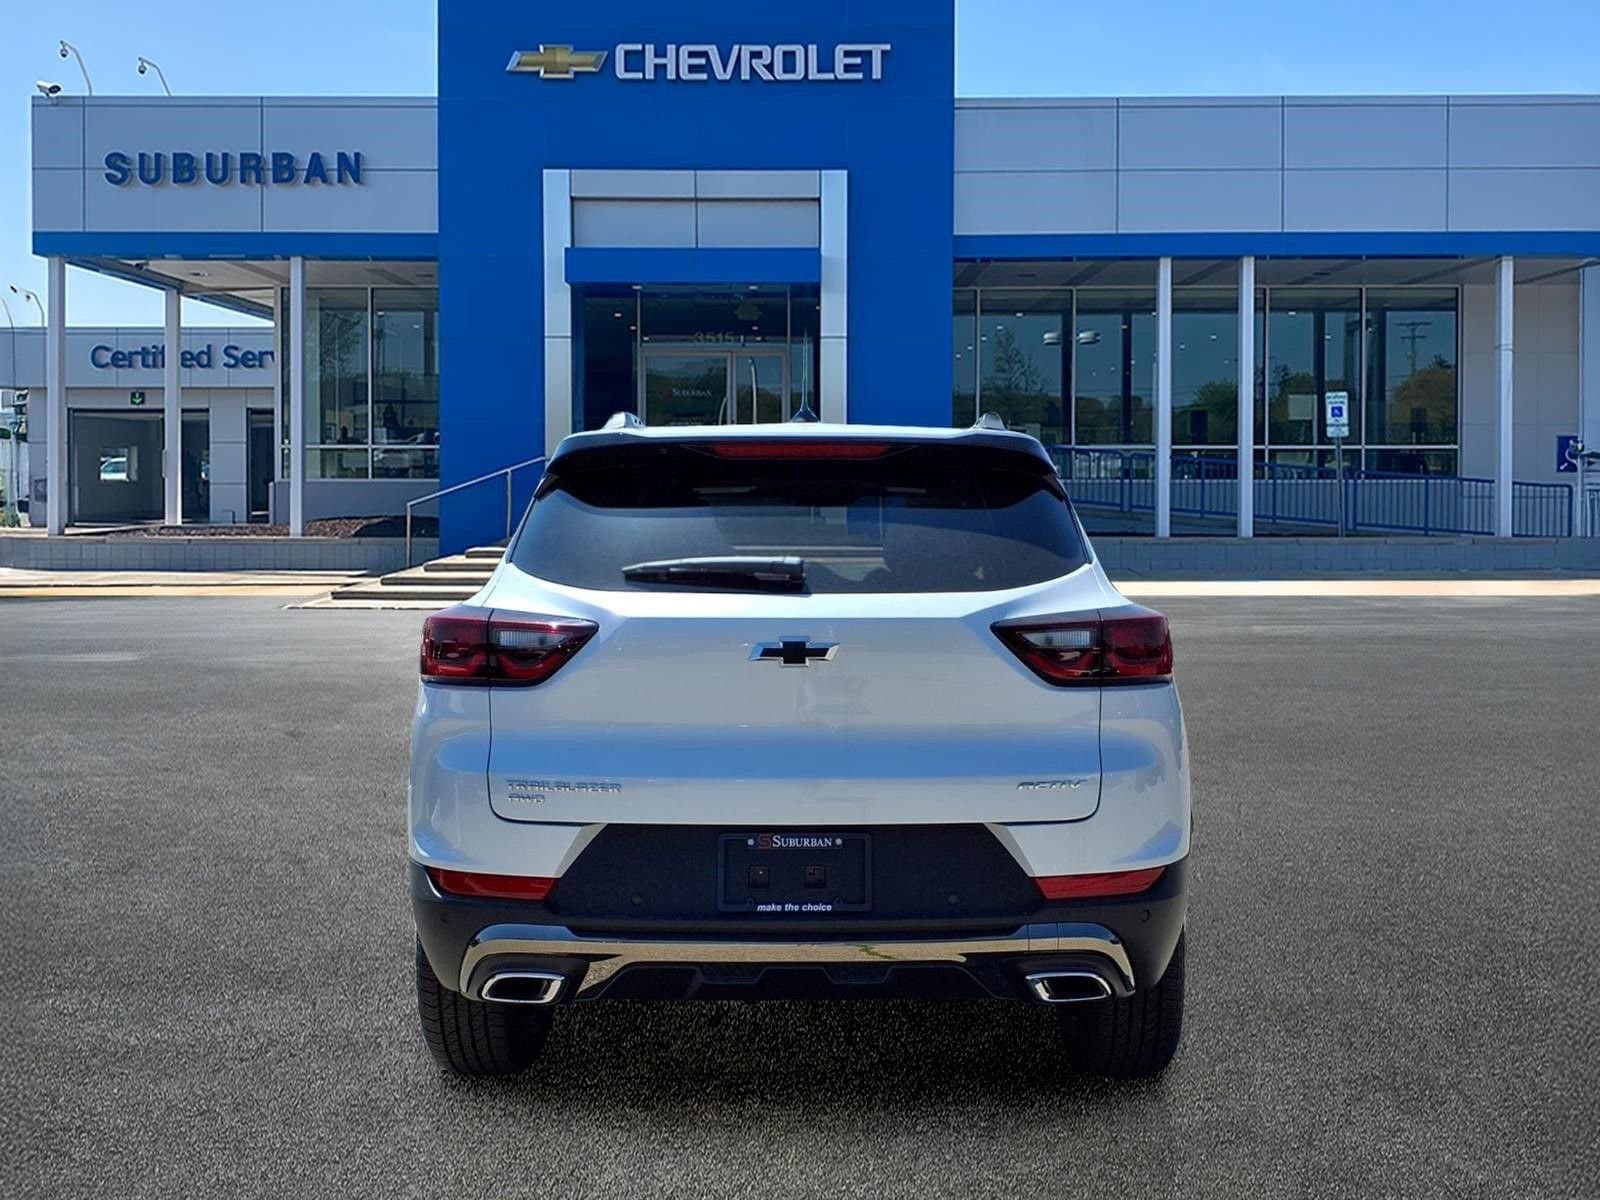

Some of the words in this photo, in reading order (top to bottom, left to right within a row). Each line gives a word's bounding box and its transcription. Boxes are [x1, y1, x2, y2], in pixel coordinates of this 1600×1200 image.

[615, 43, 891, 81] CHEVROLET
[104, 151, 362, 186] SUBURBAN
[90, 344, 213, 369] Certifed
[507, 780, 622, 792] TRAILBLAZER
[1017, 779, 1088, 790] ACTIV
[508, 793, 545, 804] AWD
[757, 903, 782, 911] make
[785, 902, 799, 911] the
[802, 902, 832, 911] choice
